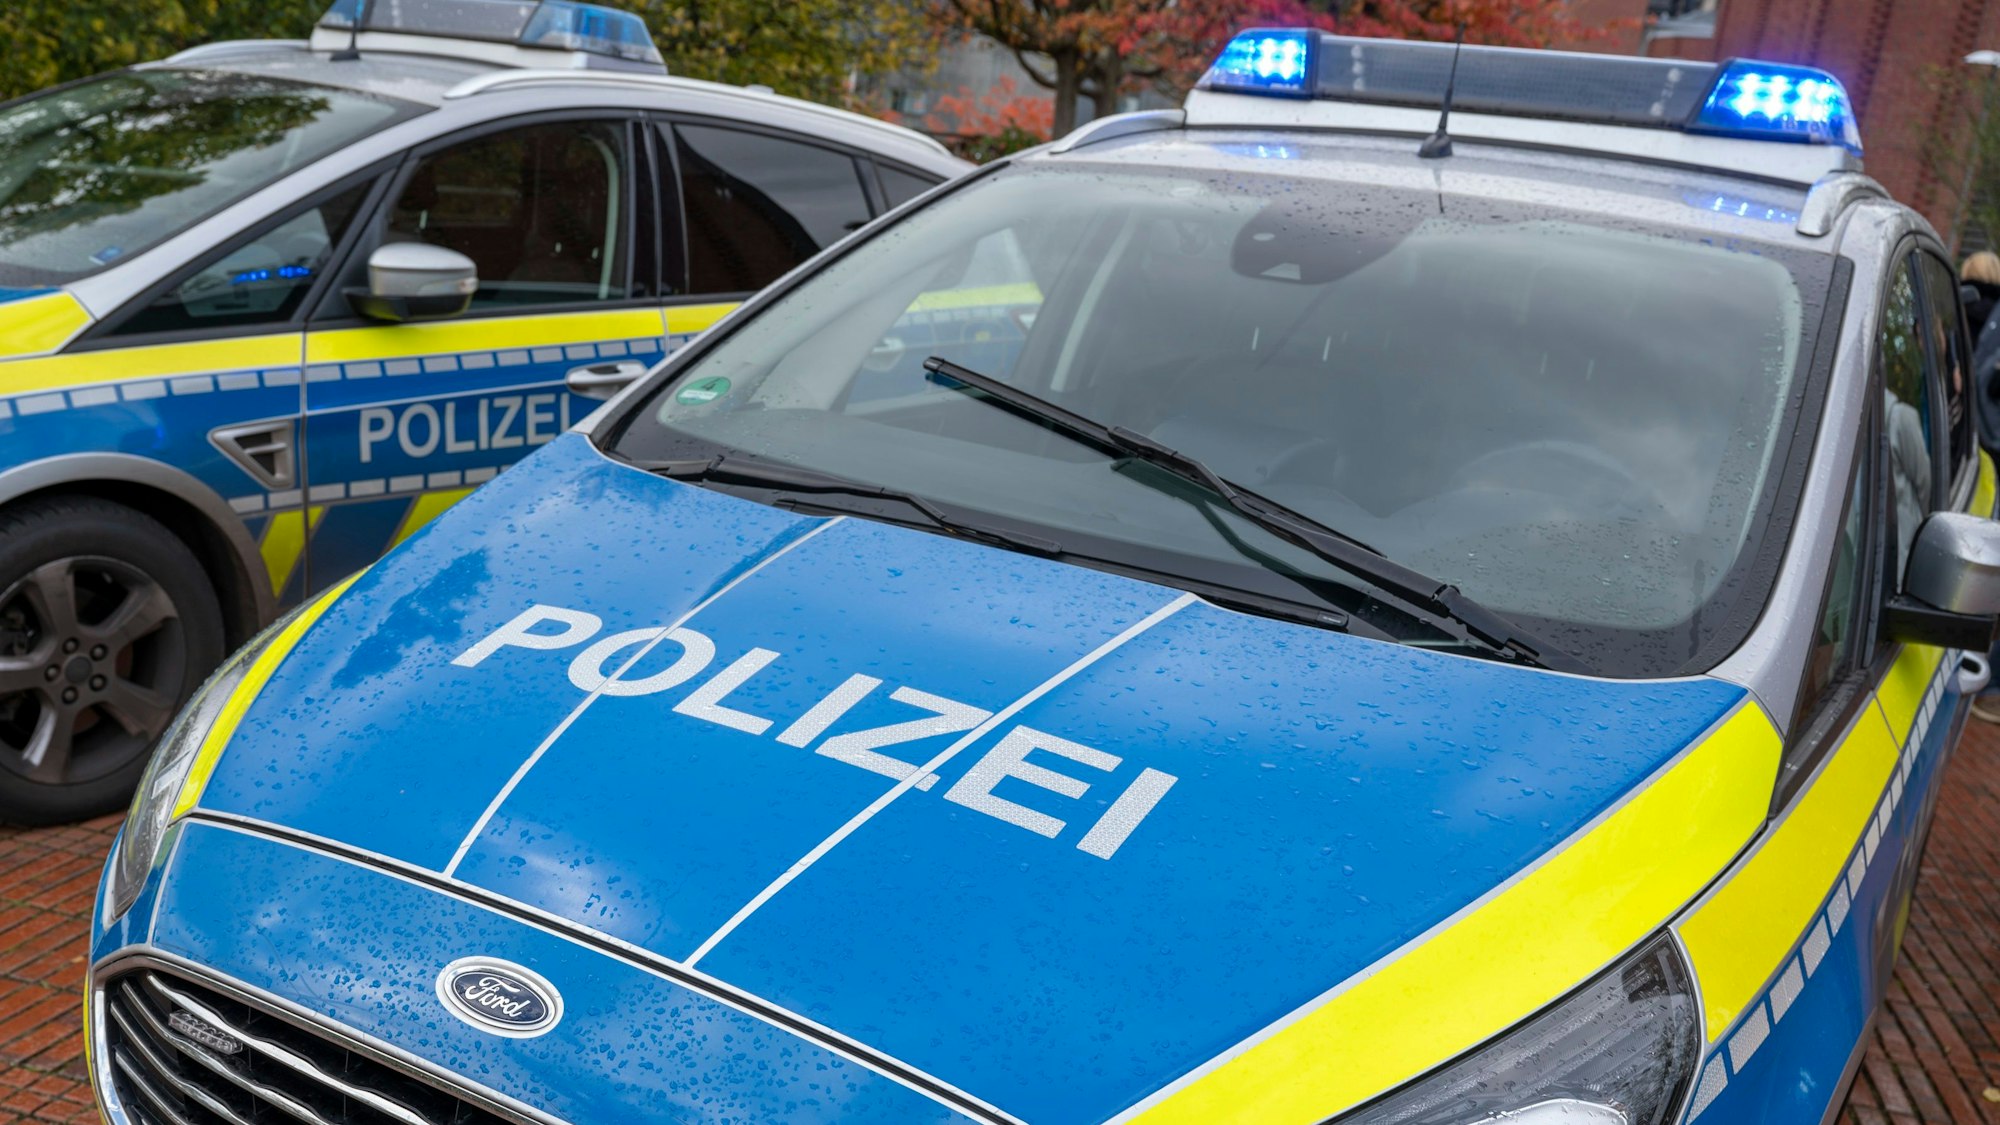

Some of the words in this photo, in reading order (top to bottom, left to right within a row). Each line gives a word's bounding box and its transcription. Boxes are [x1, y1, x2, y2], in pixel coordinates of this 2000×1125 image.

[359, 393, 570, 463] POLIZEI
[450, 604, 1178, 860] POLIZEI
[465, 977, 530, 1017] Ford
